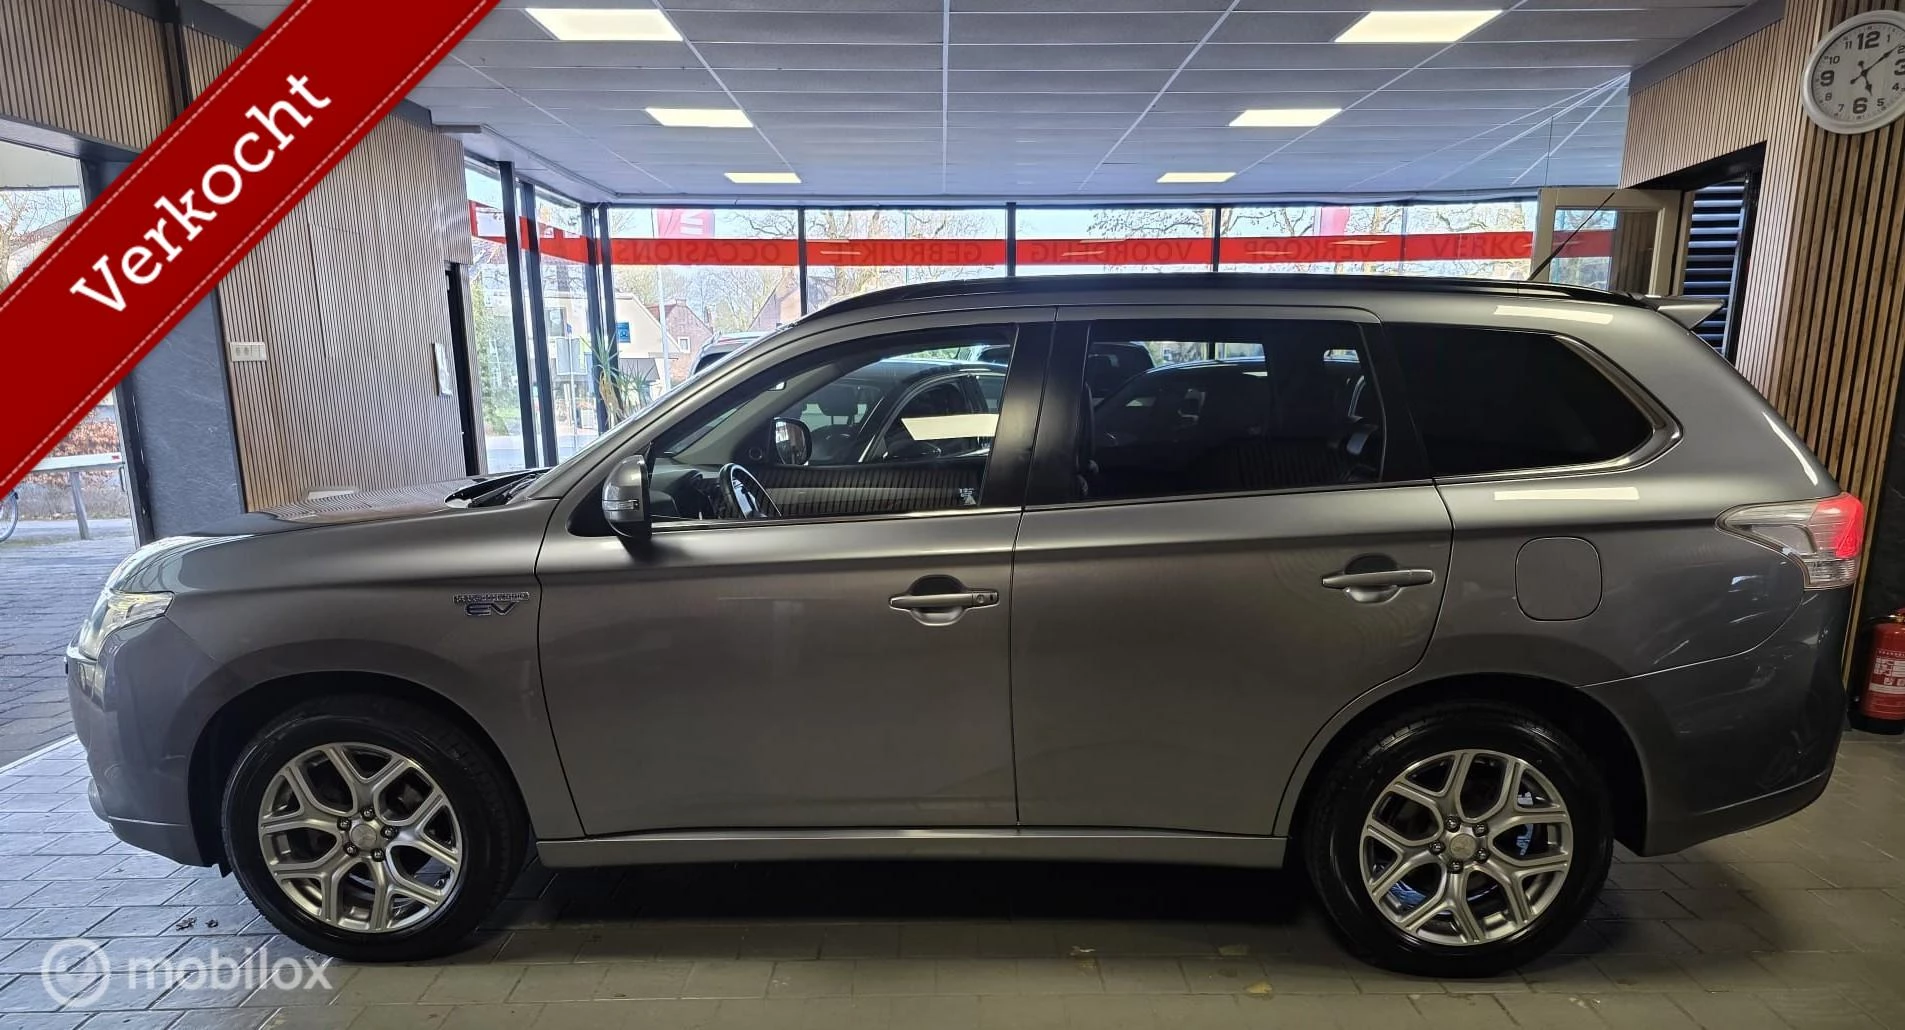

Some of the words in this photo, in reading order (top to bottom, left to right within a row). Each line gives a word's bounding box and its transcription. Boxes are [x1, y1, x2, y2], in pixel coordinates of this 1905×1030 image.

[1857, 31, 1881, 50] 12
[1887, 34, 1891, 43] 1
[1844, 40, 1853, 49] 11
[1897, 45, 1905, 54] 2
[1829, 55, 1841, 65] 10
[1894, 59, 1905, 76] 3
[1820, 70, 1835, 87] 9
[1892, 82, 1900, 91] 4
[1825, 92, 1832, 101] 8
[1852, 97, 1868, 114] 6
[1877, 98, 1885, 107] 5
[1838, 103, 1845, 112] 7
